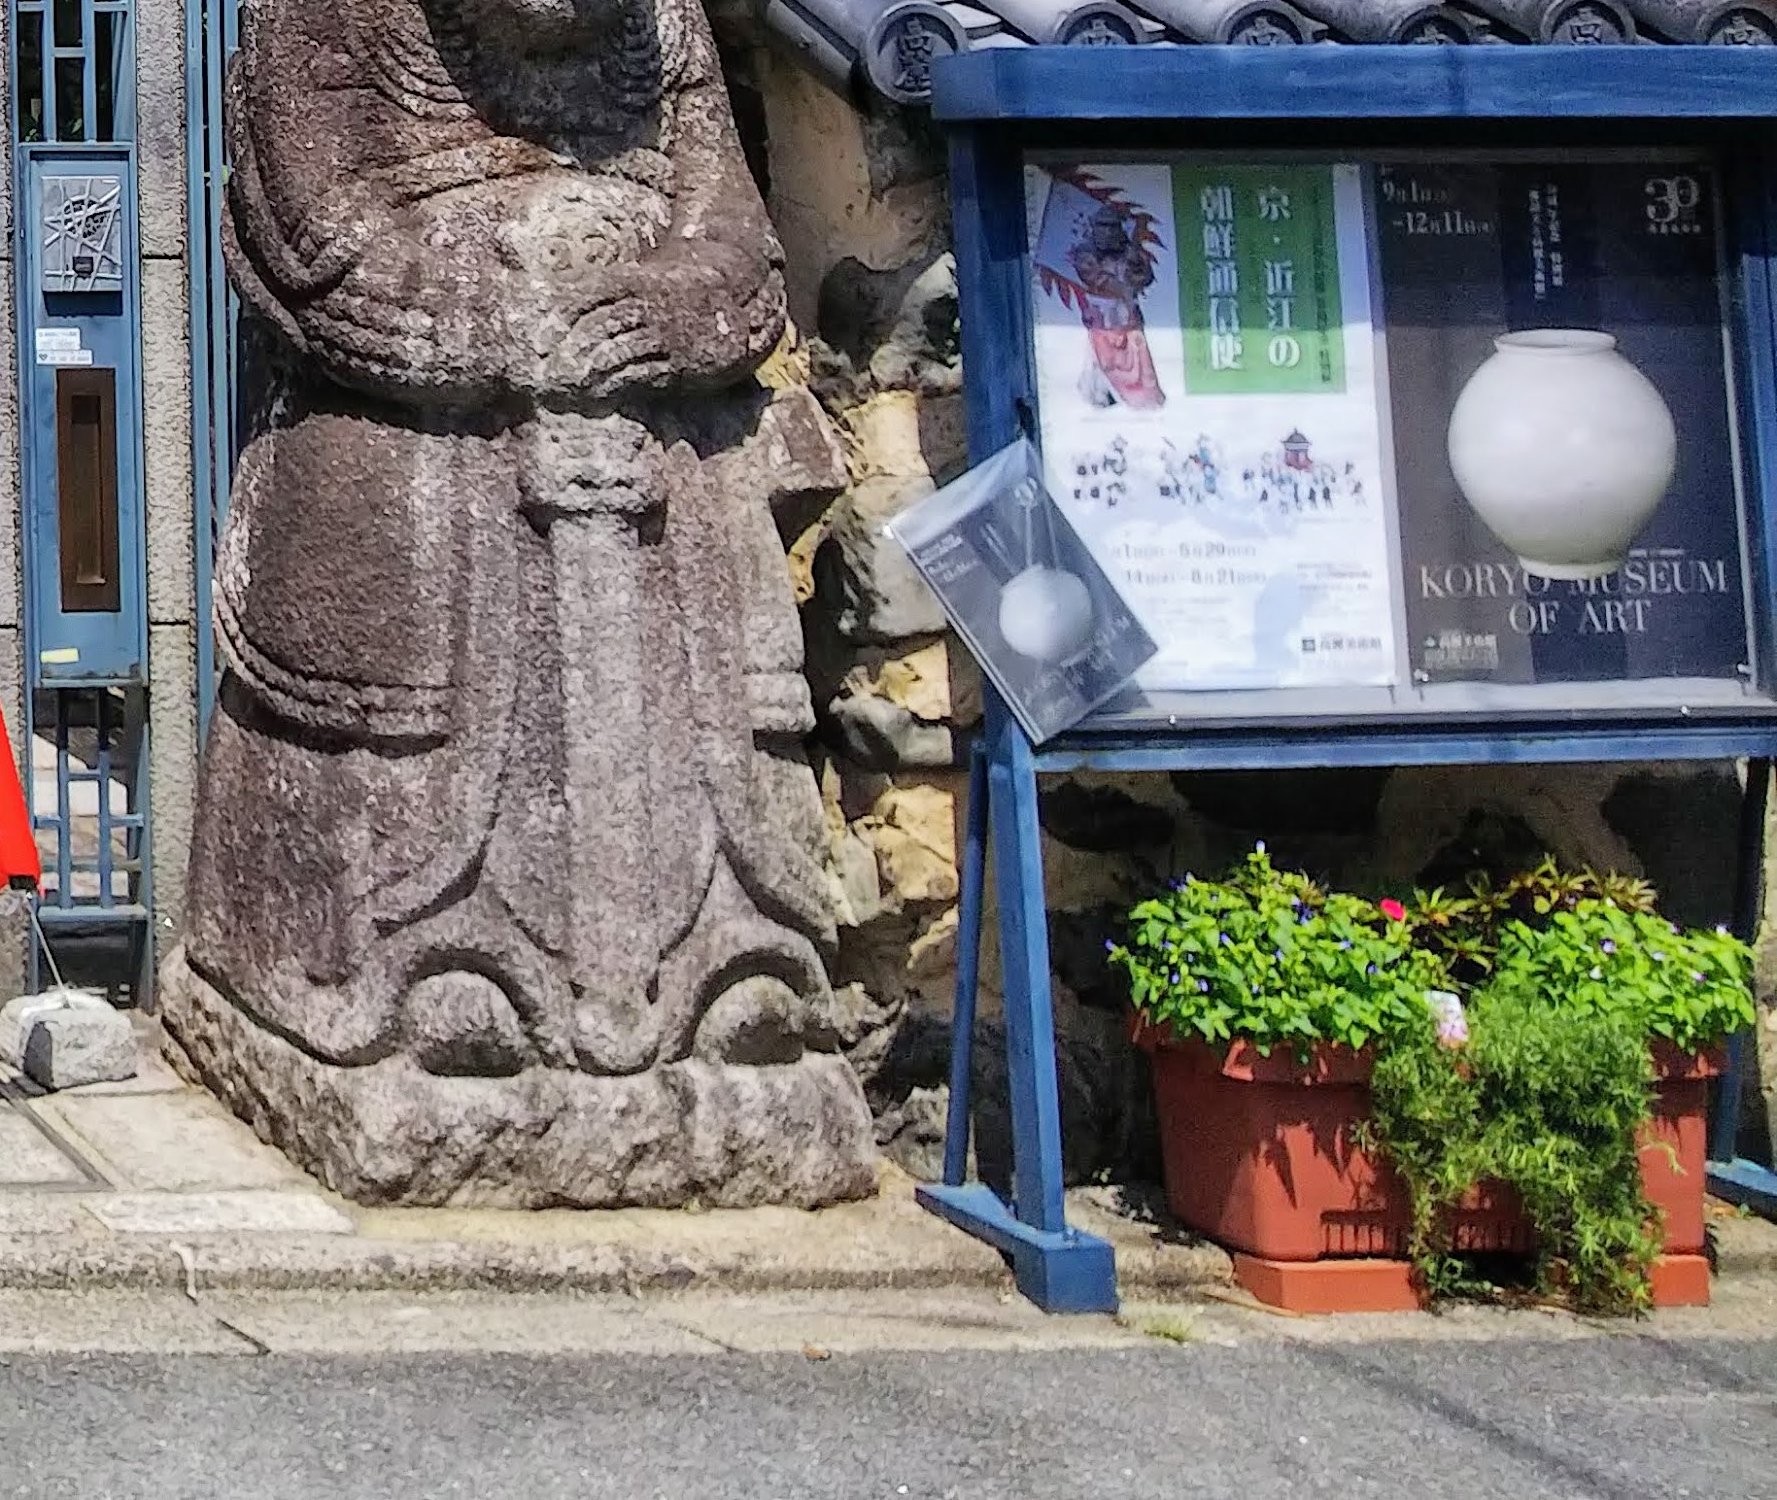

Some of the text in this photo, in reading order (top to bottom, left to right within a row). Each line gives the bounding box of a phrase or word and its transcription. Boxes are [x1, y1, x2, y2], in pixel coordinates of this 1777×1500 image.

[1259, 185, 1301, 368] 京・近江の
[1420, 558, 1730, 598] KORYO MUSEUM
[1508, 600, 1652, 634] OF ART
